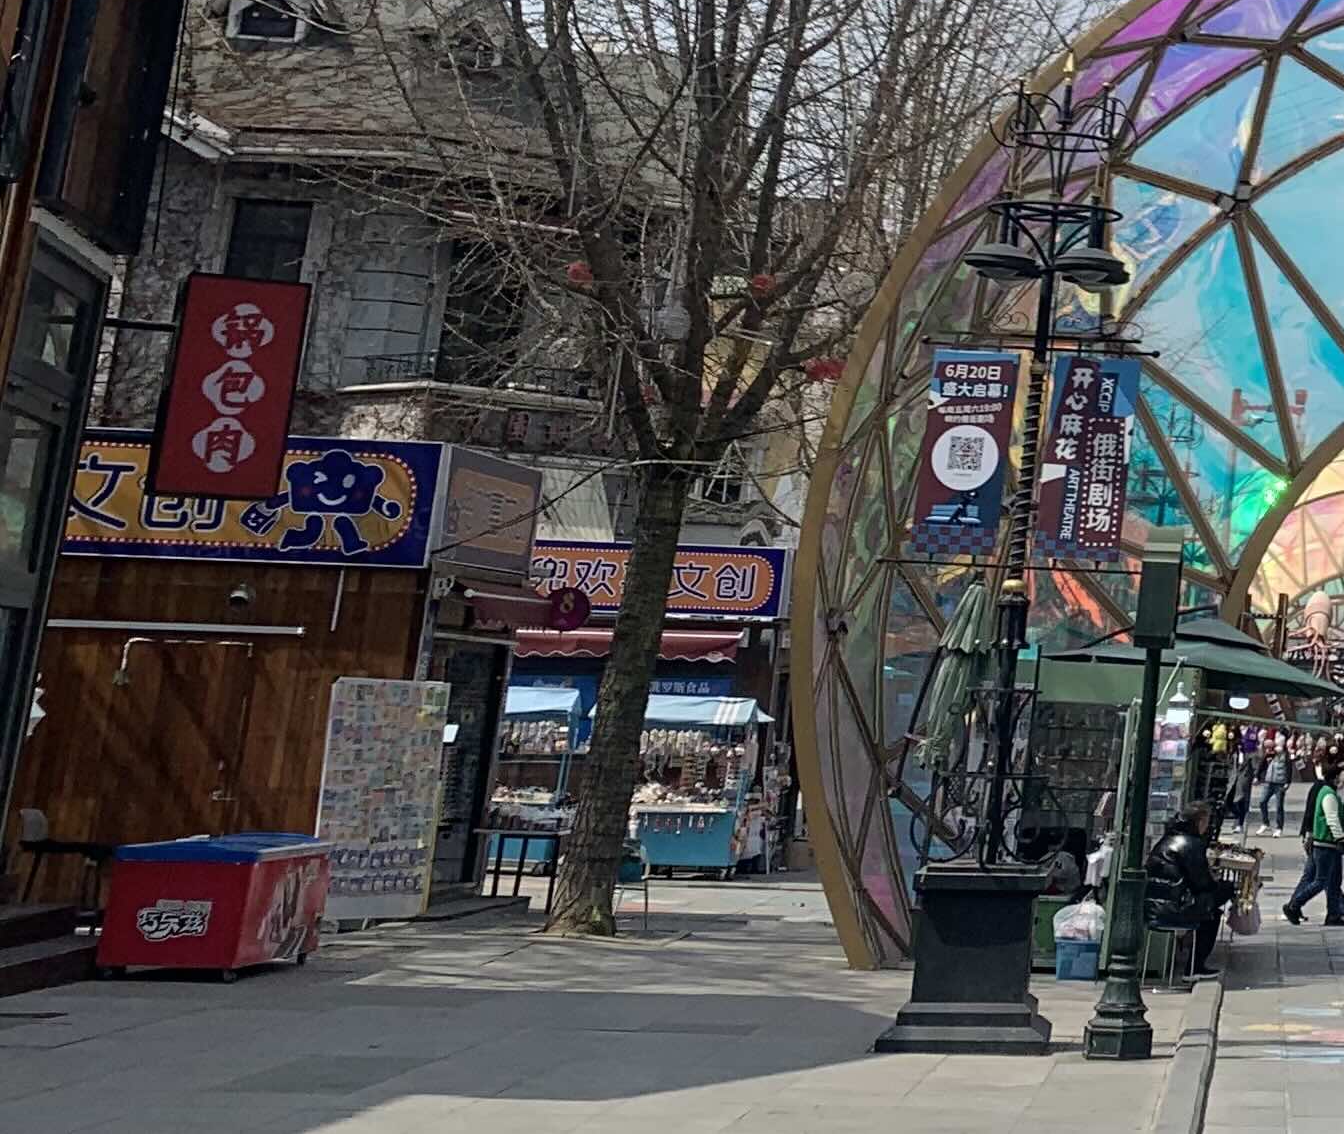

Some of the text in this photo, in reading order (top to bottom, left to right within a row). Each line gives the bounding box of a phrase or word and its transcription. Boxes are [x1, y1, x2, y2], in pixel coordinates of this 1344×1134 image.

[198, 305, 273, 471] 锅包肉
[944, 364, 1002, 381] 6月20日
[1054, 367, 1094, 460] 开心麻花
[1059, 468, 1081, 541] ART THEATRE
[1085, 432, 1119, 533] 俄街剧场
